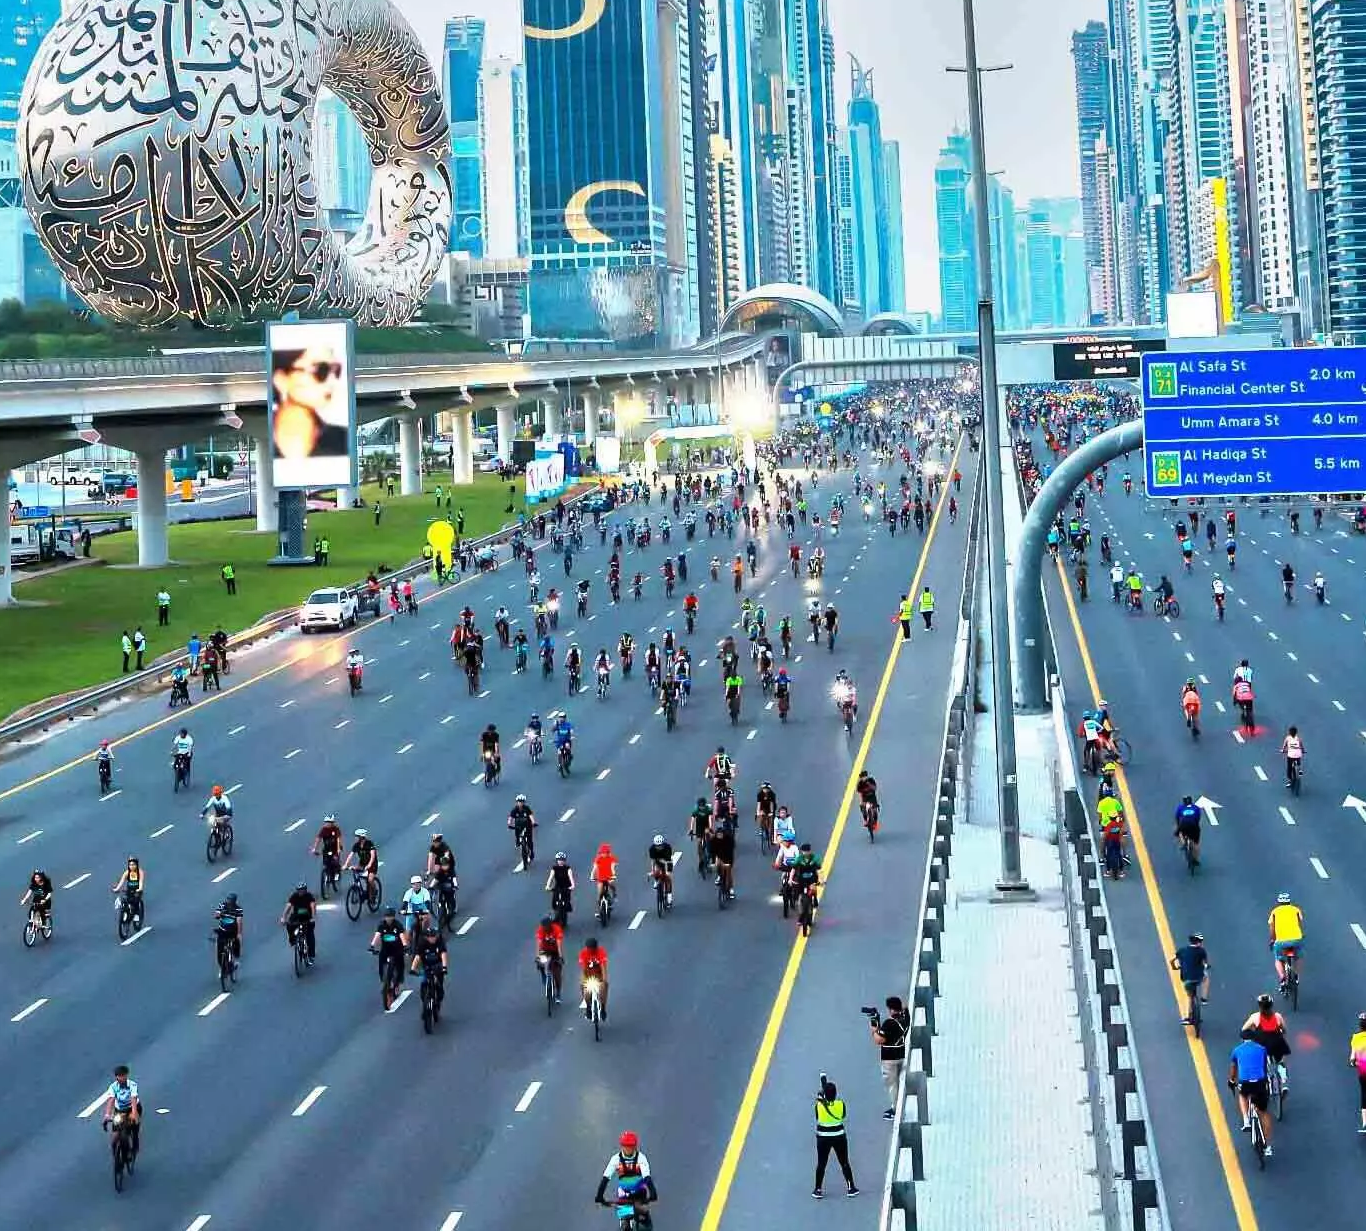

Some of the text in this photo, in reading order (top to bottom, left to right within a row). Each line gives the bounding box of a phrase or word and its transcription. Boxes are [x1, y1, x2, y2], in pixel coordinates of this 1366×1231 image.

[1179, 359, 1247, 373] Al Safa St
[1310, 368, 1356, 381] 2.0 km
[1156, 380, 1172, 393] 71
[1180, 381, 1306, 396] Financial Center St
[1181, 414, 1280, 429] Umm Amara St
[1312, 412, 1358, 425] 4.0 km
[1183, 448, 1267, 462] Al Hadiqa St
[1314, 457, 1360, 470] 5.5 km
[1157, 468, 1177, 482] 69
[1185, 471, 1272, 486] Al Meydan St
